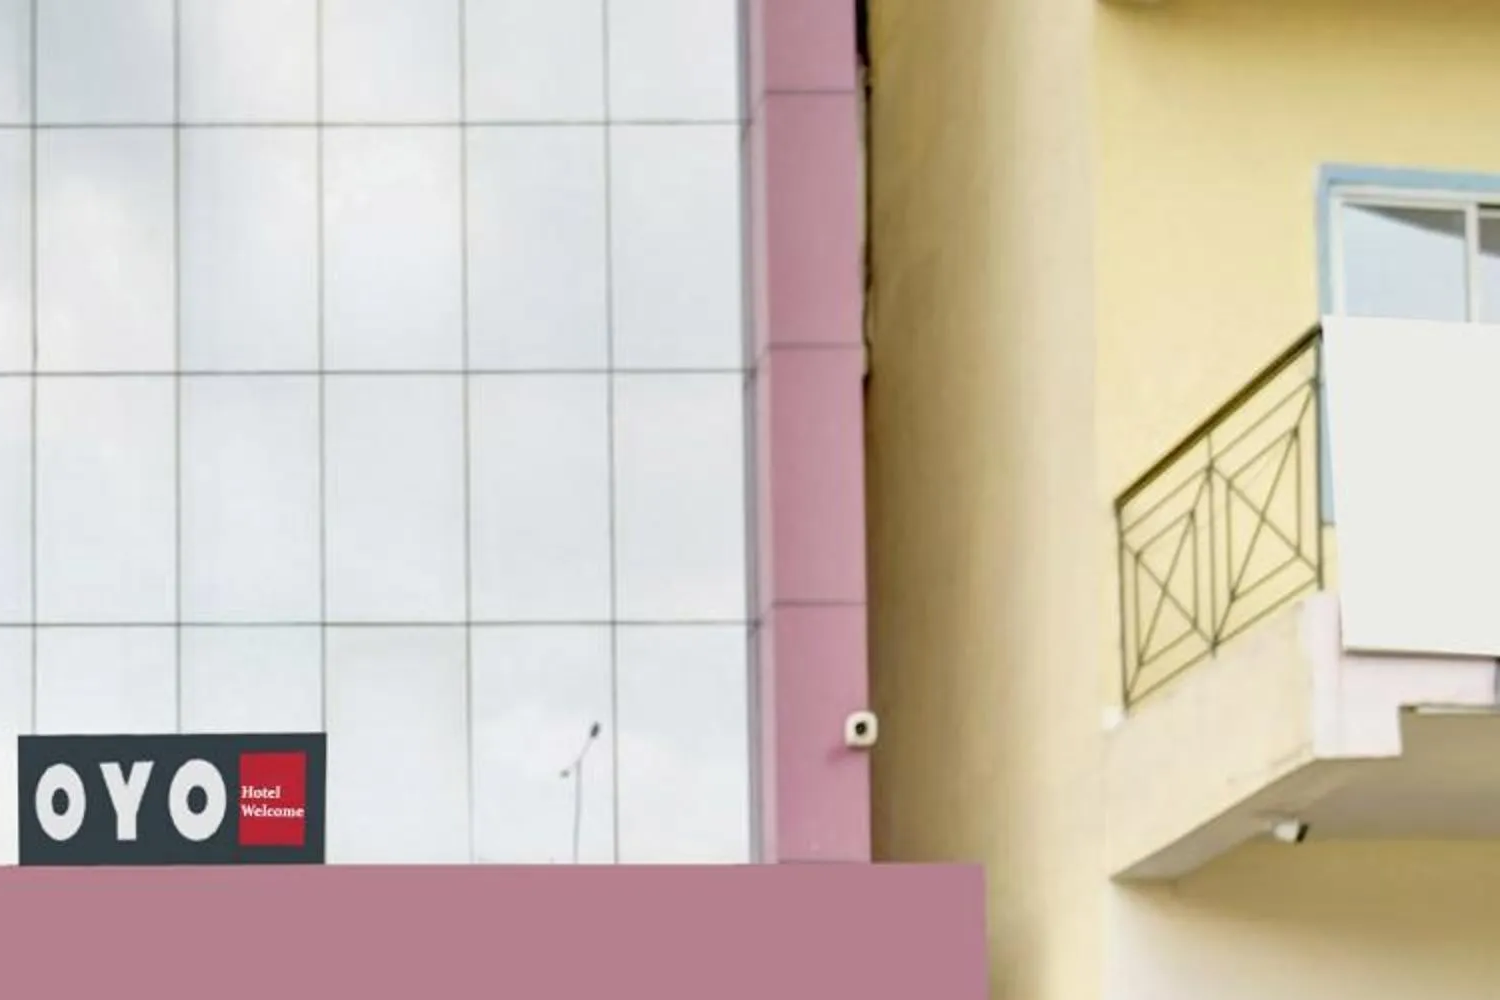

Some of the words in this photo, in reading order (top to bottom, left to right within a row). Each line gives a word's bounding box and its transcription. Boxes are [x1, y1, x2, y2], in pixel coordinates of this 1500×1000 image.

[240, 785, 281, 799] Hotel
[35, 758, 227, 841] OYO
[240, 804, 305, 817] Welcome
